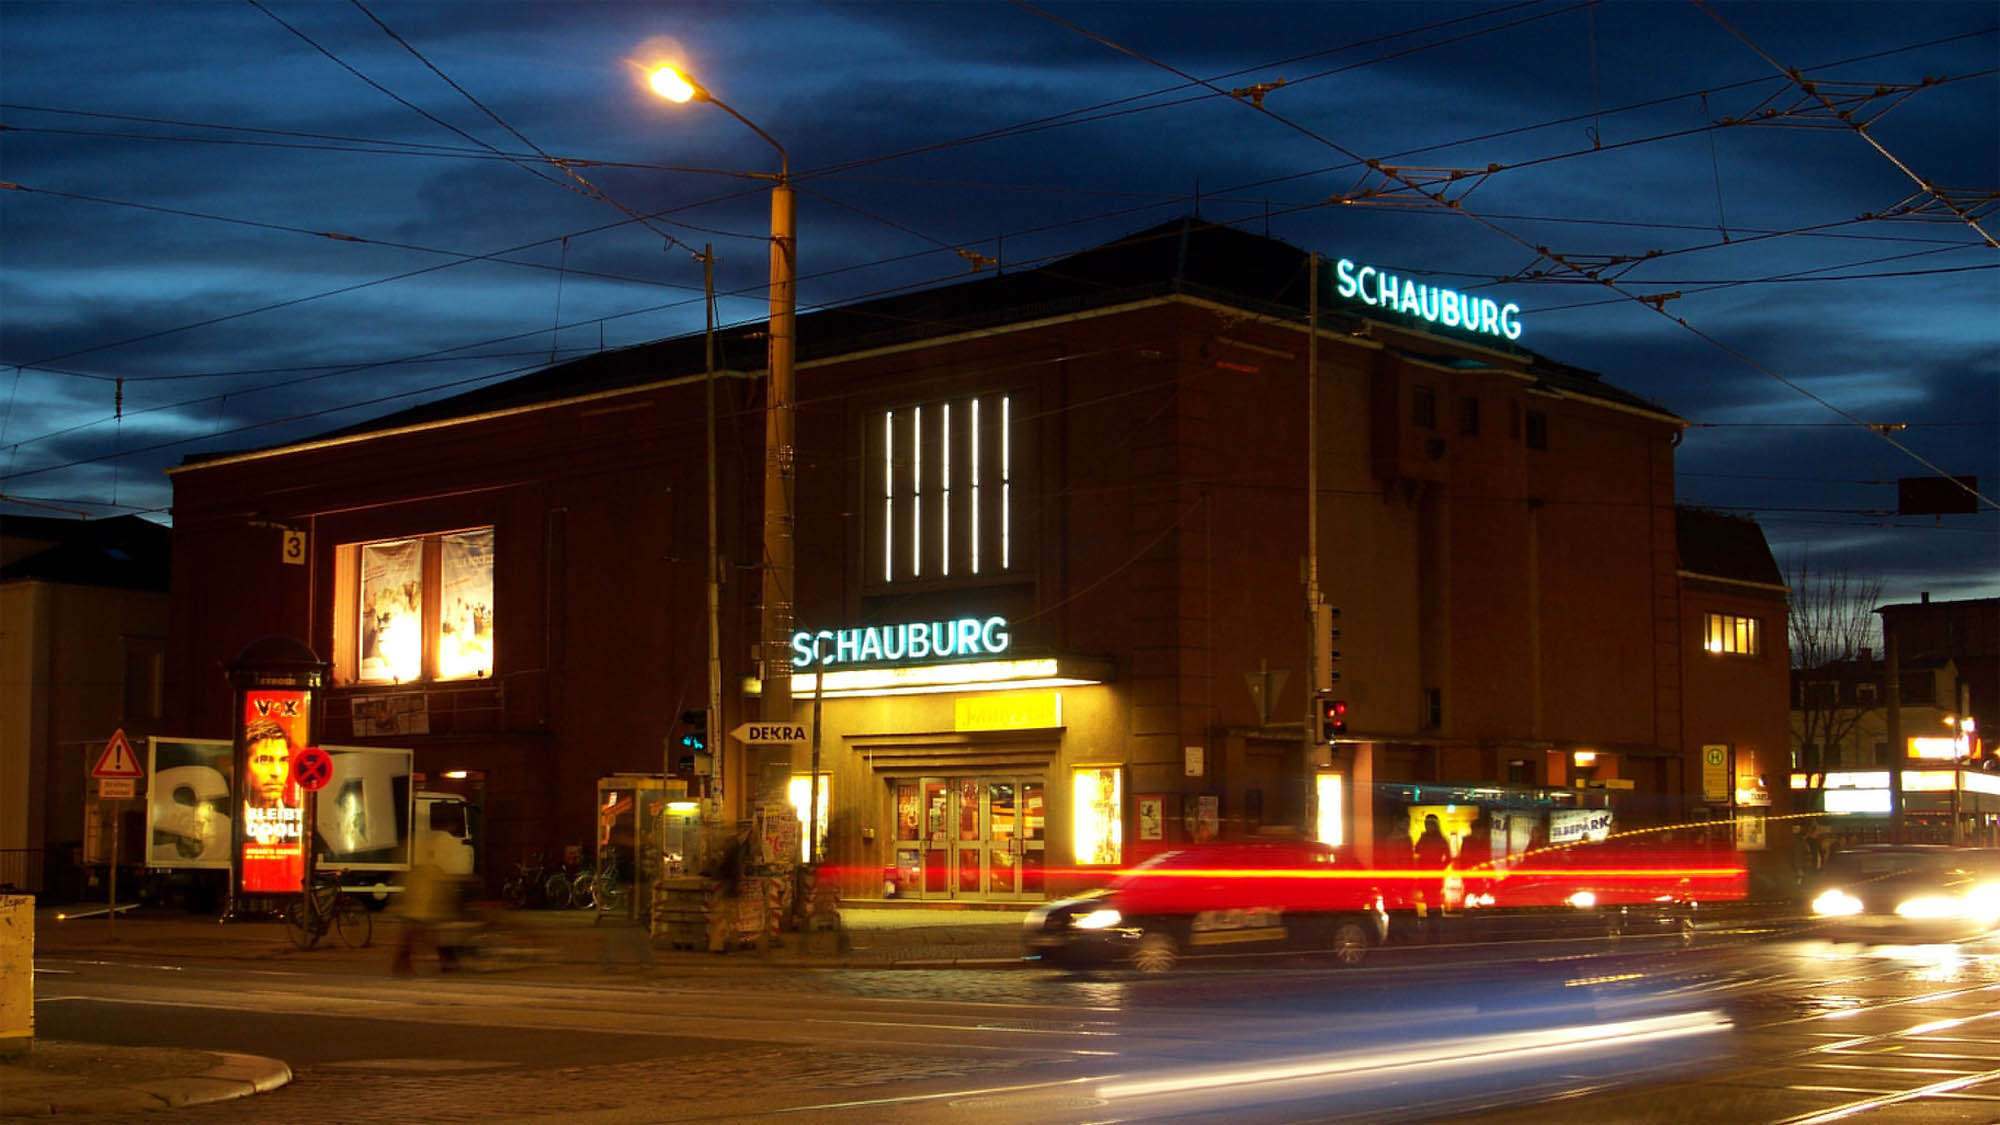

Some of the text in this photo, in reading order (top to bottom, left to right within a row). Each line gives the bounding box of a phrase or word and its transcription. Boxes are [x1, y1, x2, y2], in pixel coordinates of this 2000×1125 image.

[1337, 259, 1521, 340] SCHAUBURG
[287, 537, 301, 558] 3
[792, 616, 1008, 667] SCHAUBURG
[749, 726, 806, 740] DEKRA
